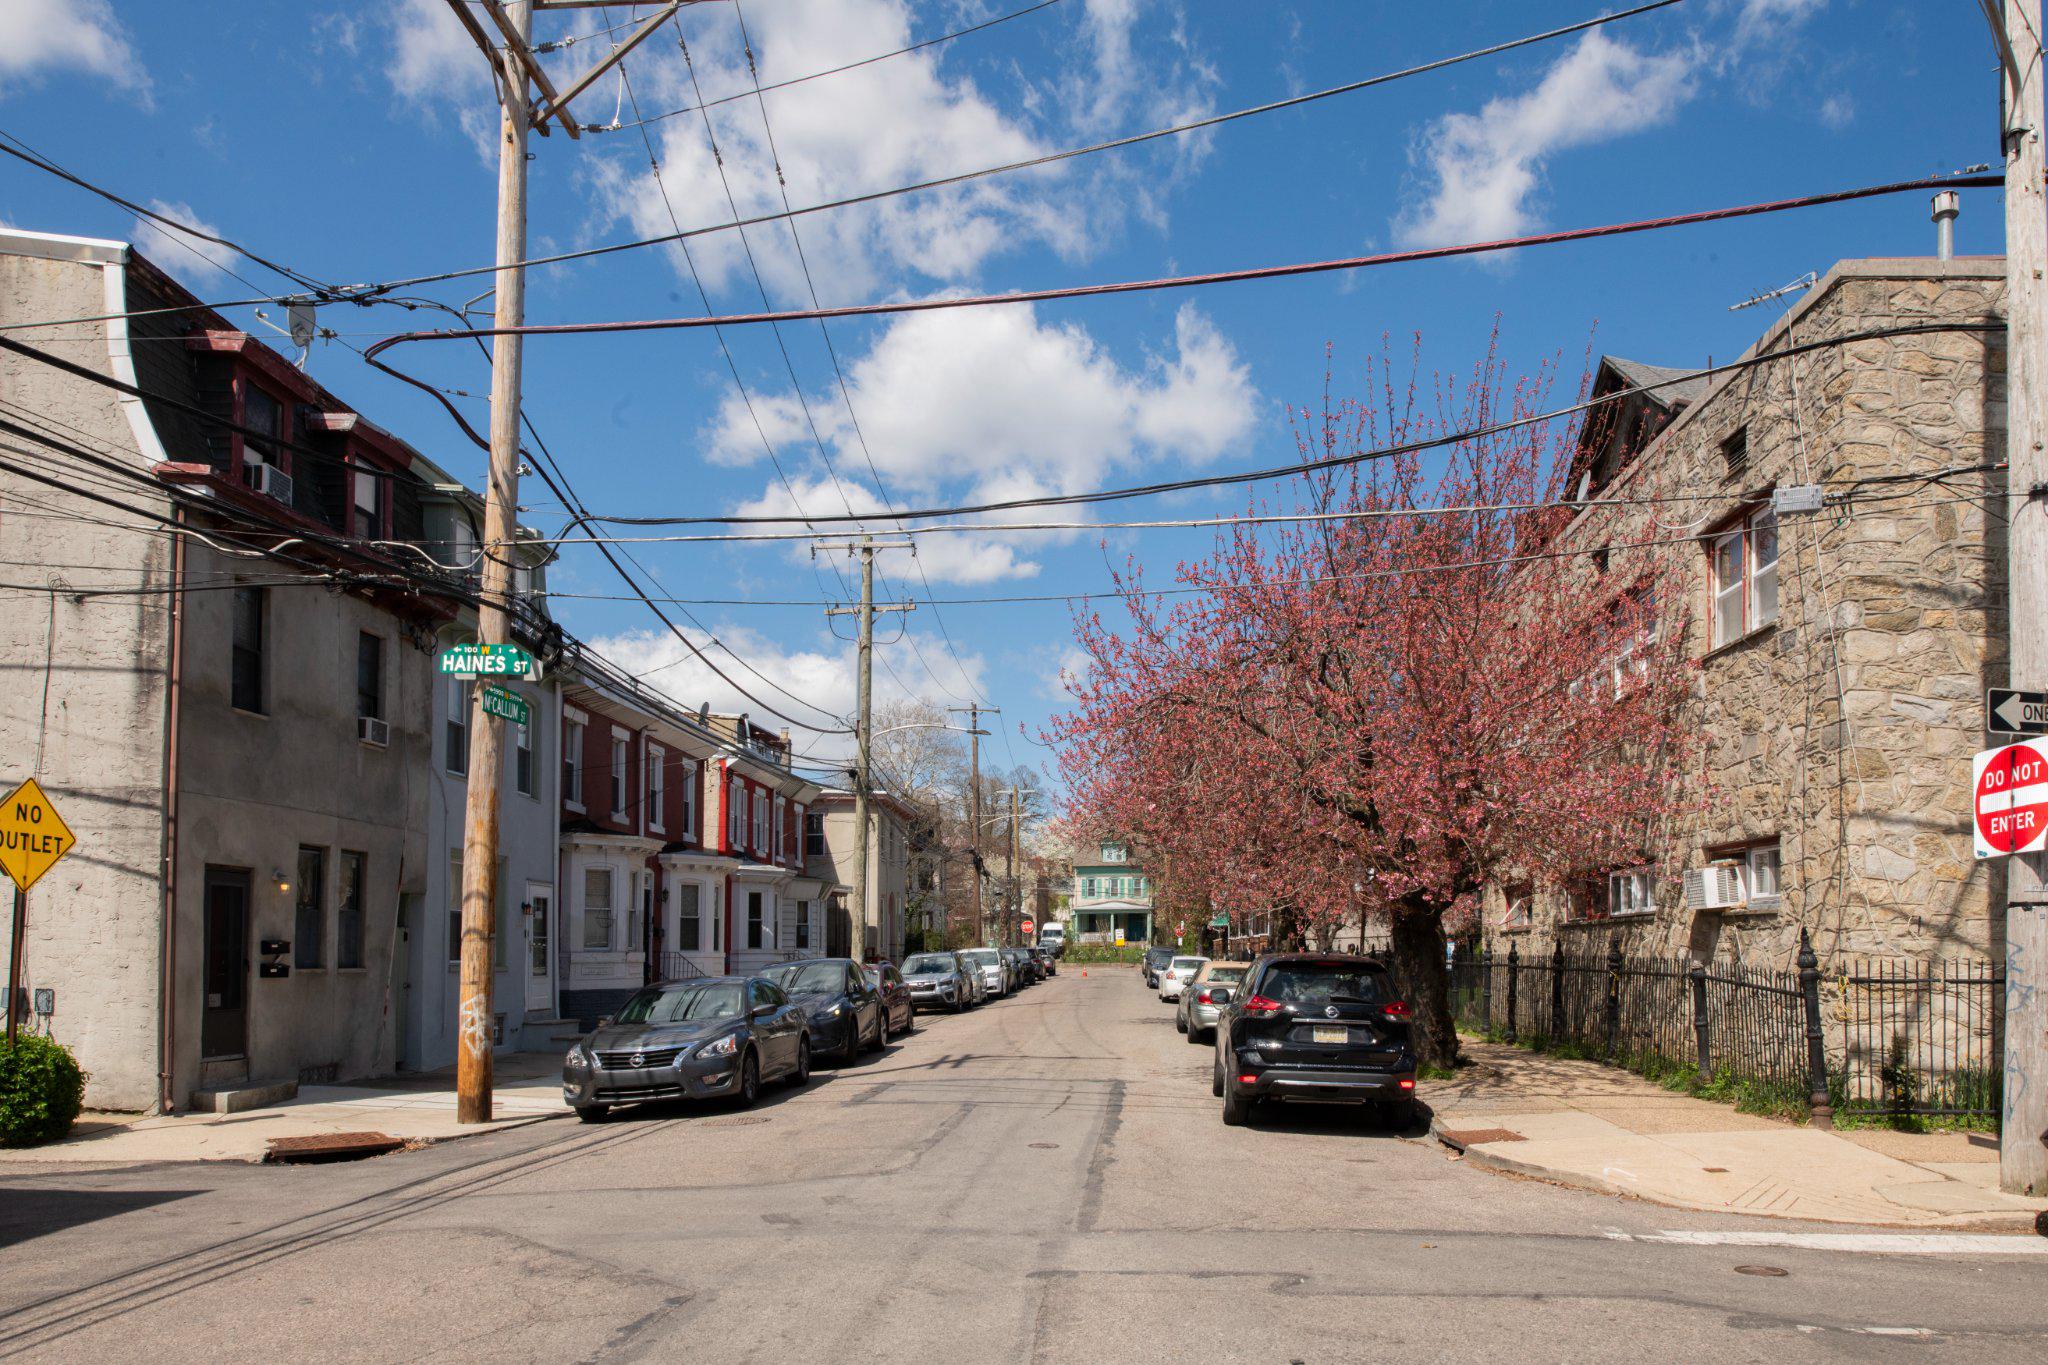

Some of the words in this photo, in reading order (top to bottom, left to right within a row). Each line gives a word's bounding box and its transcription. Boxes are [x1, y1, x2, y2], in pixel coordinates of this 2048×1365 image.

[481, 645, 490, 655] W
[442, 654, 506, 672] HAINES
[513, 661, 528, 672] ST
[520, 710, 526, 723] ST
[1985, 769, 2004, 789] DO
[2011, 761, 2041, 782] NOT
[16, 802, 42, 824] NO
[1991, 810, 2035, 835] ENTER
